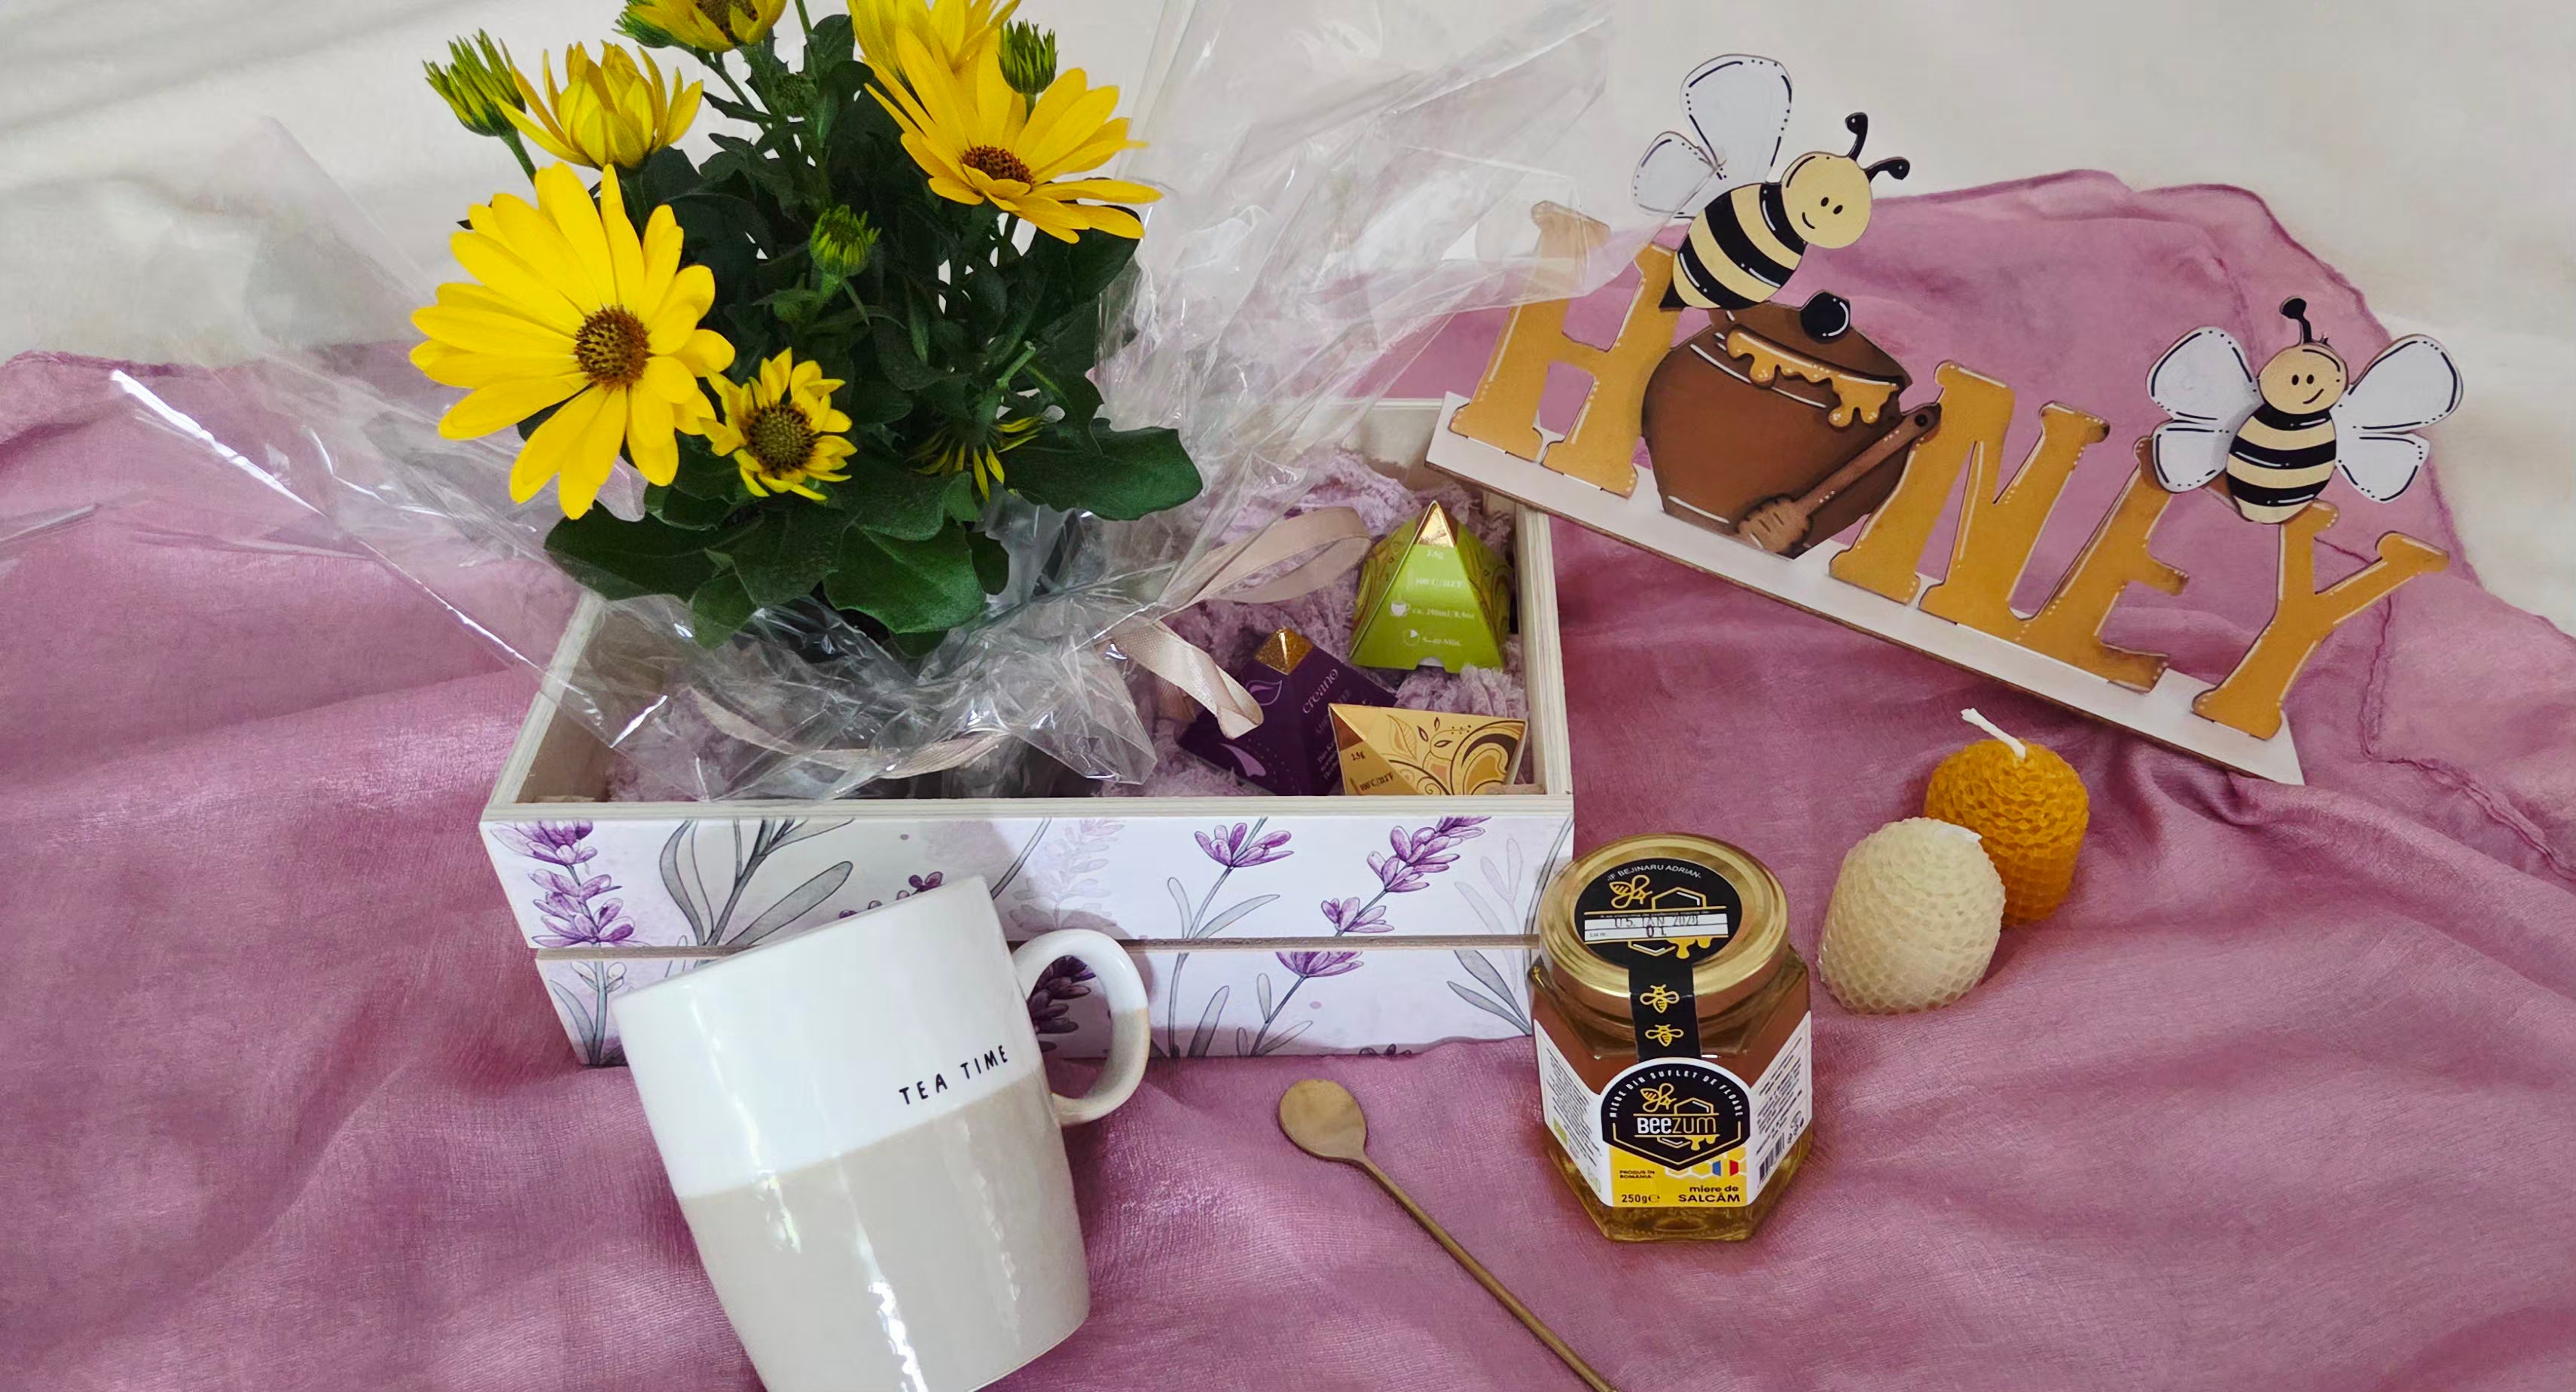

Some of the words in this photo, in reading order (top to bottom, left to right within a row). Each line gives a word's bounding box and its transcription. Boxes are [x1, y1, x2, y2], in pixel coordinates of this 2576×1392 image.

[1302, 668, 1338, 714] creano
[1617, 863, 1665, 878] BEJINARU
[899, 1073, 948, 1105] TEA
[960, 1045, 1008, 1079] TIME
[1625, 1076, 1646, 1090] DIN
[1650, 1070, 1699, 1079] SUFLET
[1702, 1075, 1717, 1085] DE
[1718, 1084, 1744, 1116] FLOARE
[1678, 1192, 1741, 1203] SALCÂM
[1689, 1185, 1722, 1193] miere
